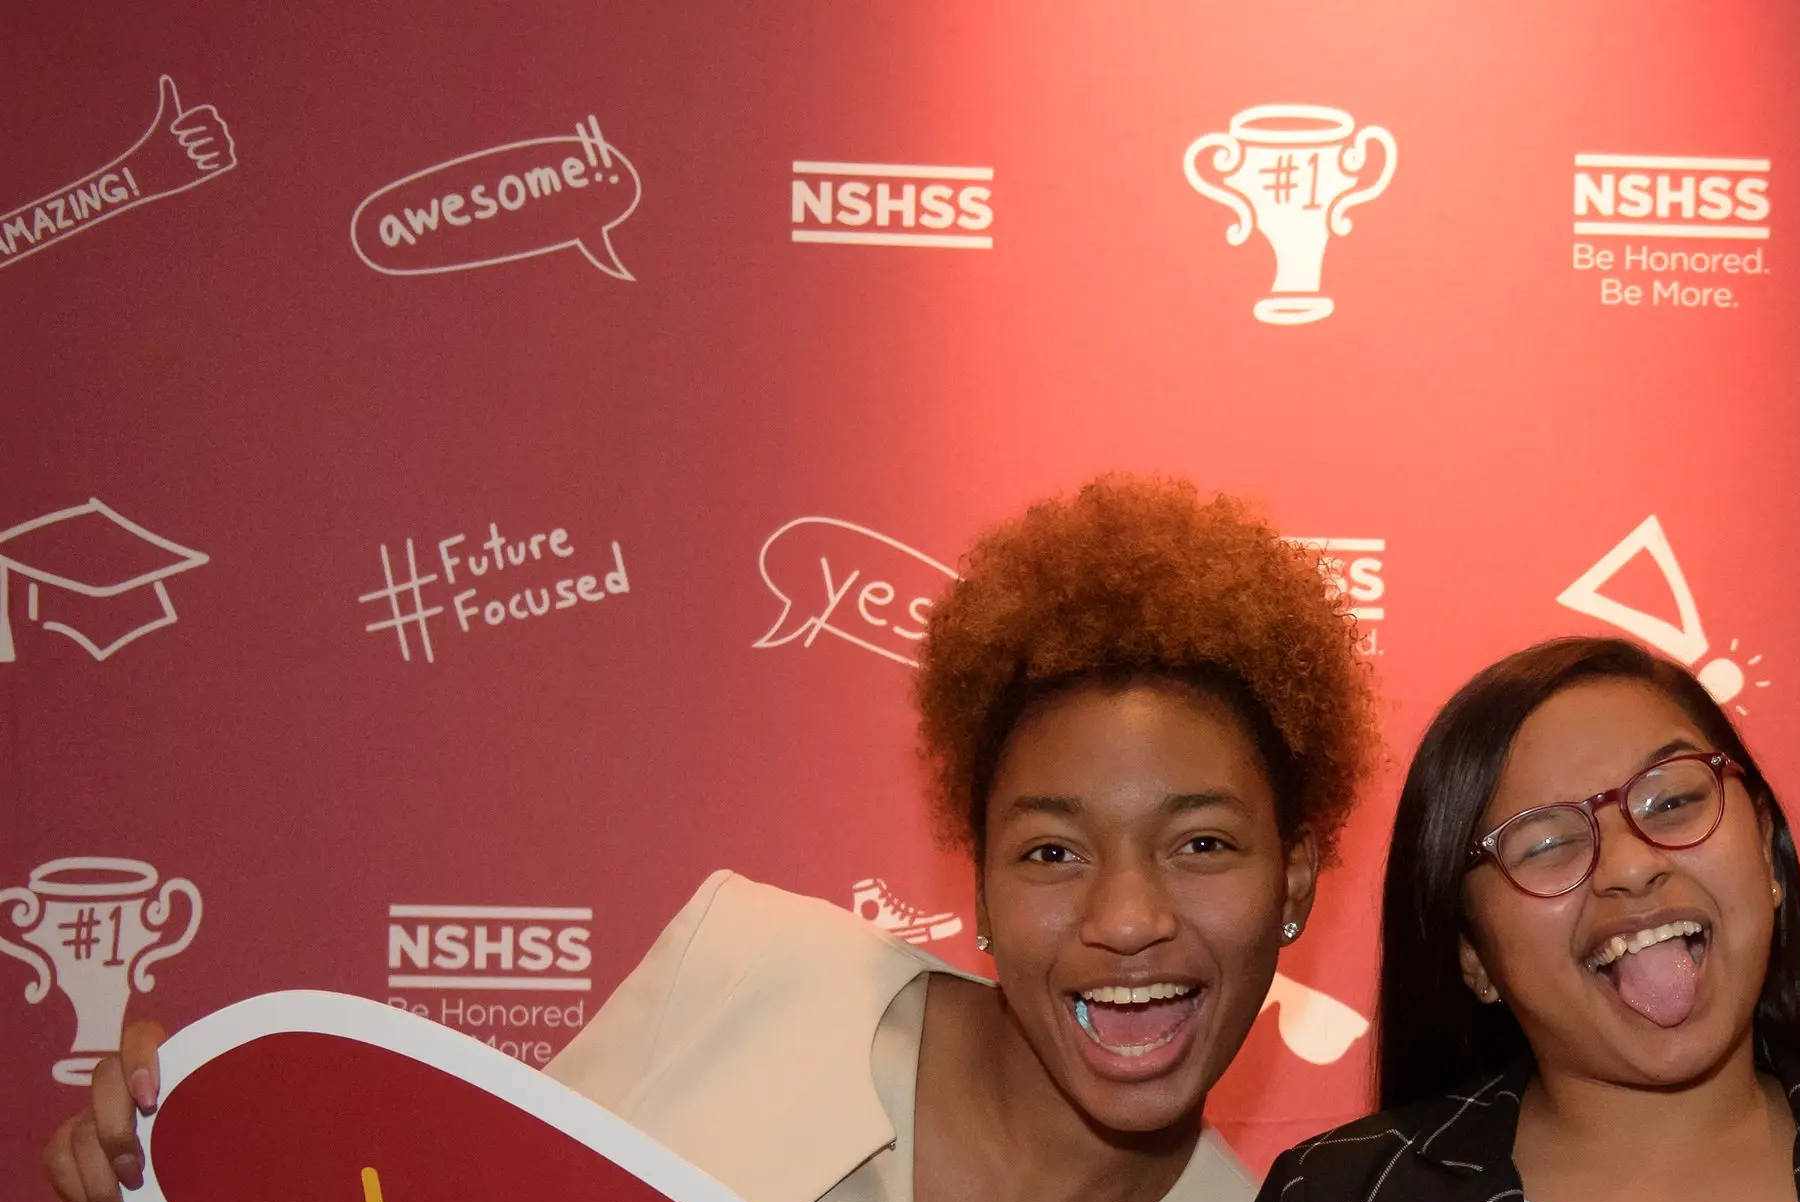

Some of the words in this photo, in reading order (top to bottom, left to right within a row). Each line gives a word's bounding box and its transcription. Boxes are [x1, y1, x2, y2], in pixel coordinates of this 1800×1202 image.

[378, 114, 620, 247] awesome!!
[1258, 152, 1322, 211] #1
[1574, 174, 1770, 222] NSHSS
[792, 181, 993, 231] NSHSS
[1573, 243, 1614, 271] Be
[1624, 245, 1770, 275] Honored.
[1601, 278, 1642, 306] Be
[1652, 280, 1739, 309] More.
[453, 541, 631, 632] Focused
[803, 557, 935, 648] yes
[58, 905, 124, 967] #1
[388, 924, 592, 972] NSHSS
[442, 998, 585, 1028] Honored
